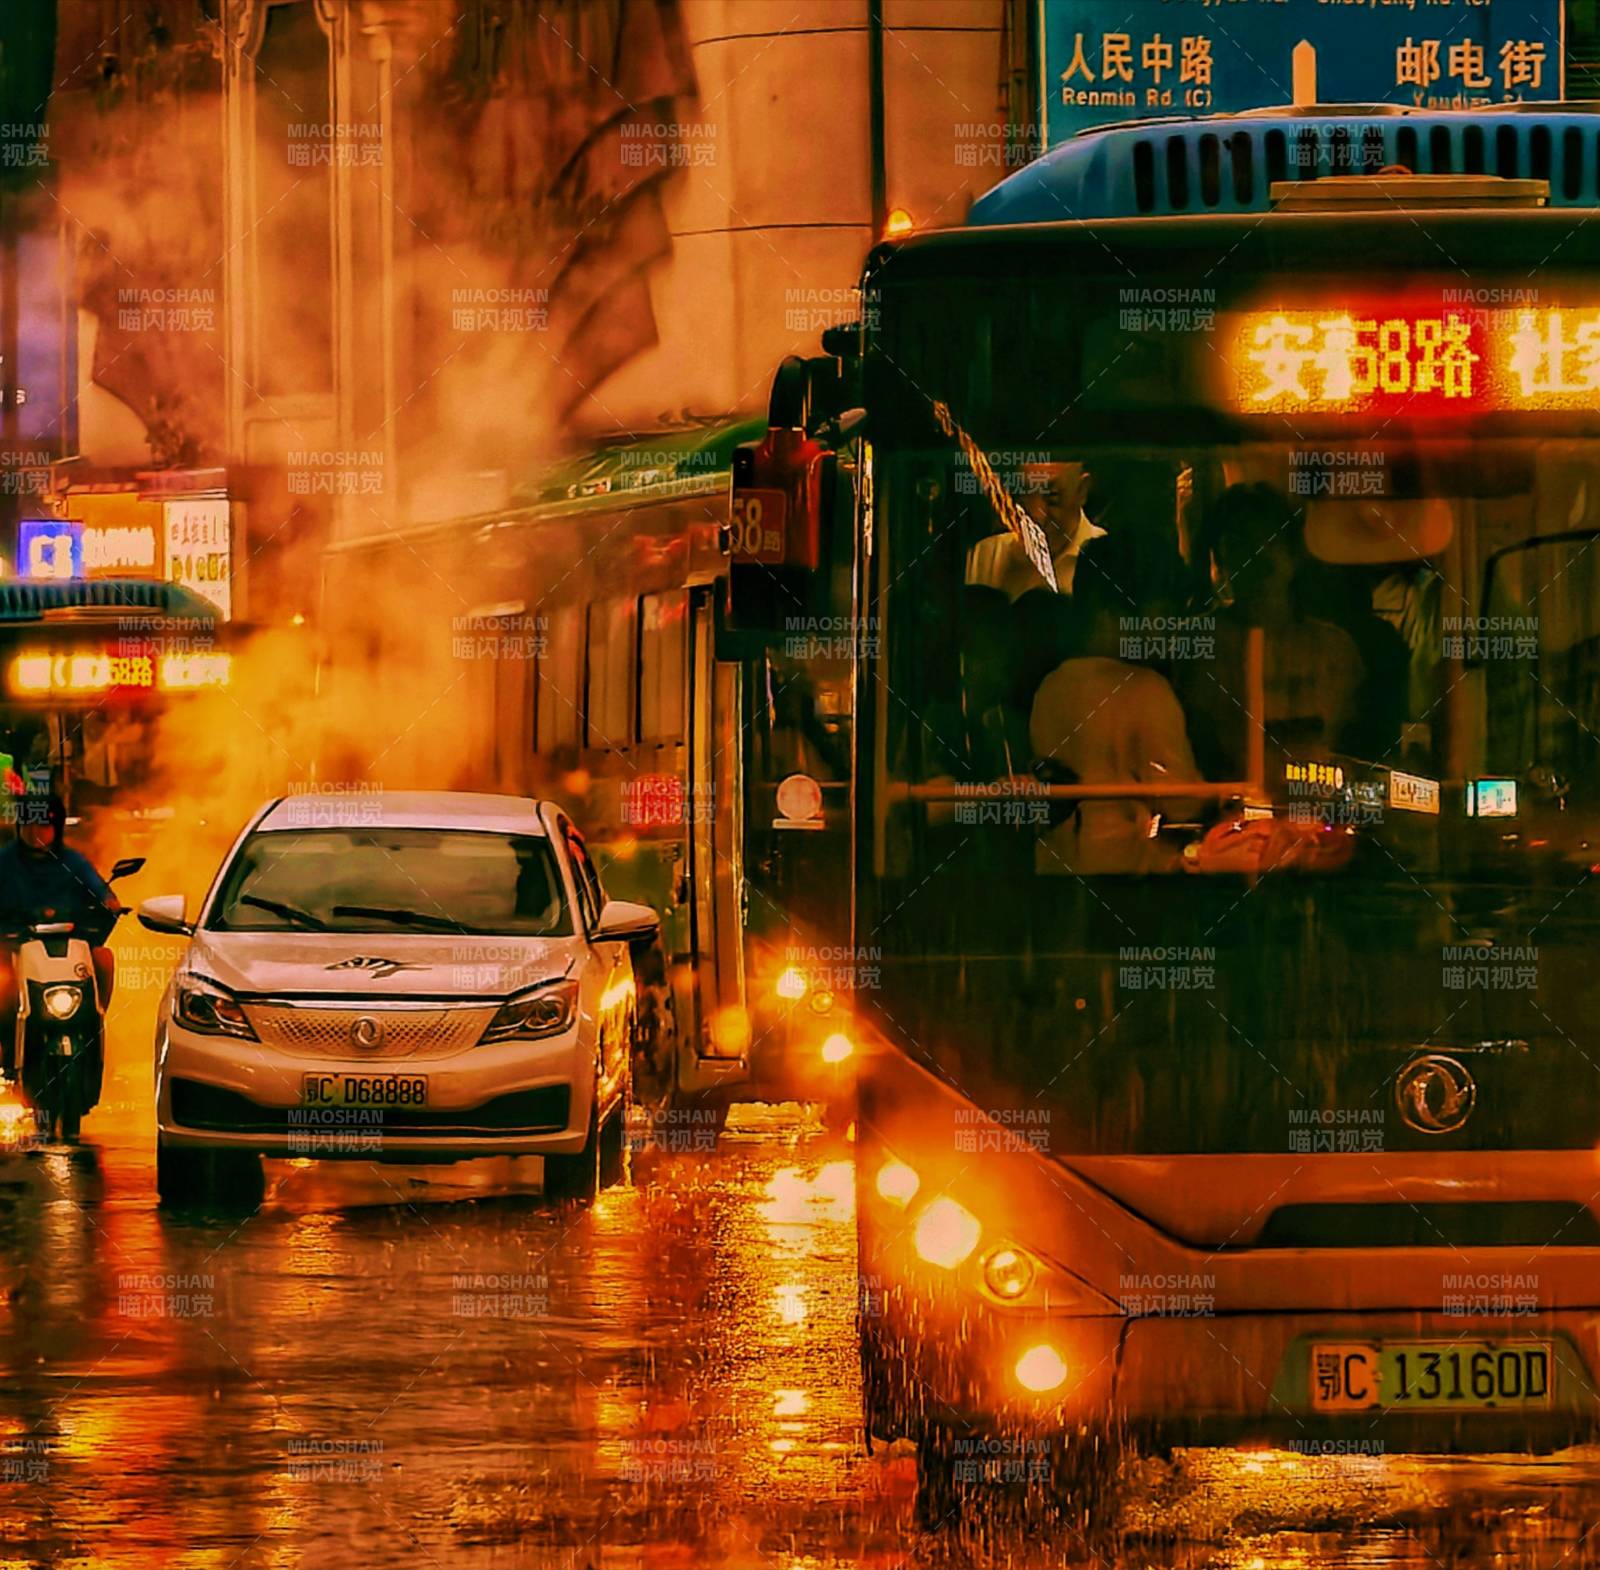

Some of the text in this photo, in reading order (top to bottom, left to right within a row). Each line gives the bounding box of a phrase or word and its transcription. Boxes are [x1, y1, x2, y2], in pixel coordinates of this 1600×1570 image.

[1060, 33, 1214, 85] 人民中路
[1396, 37, 1547, 89] 邮电街
[1062, 87, 1136, 107] Renmin
[1185, 89, 1212, 108] (C)
[343, 1078, 425, 1105] D68888
[1317, 1352, 1548, 1400] 鄂C 13160D
